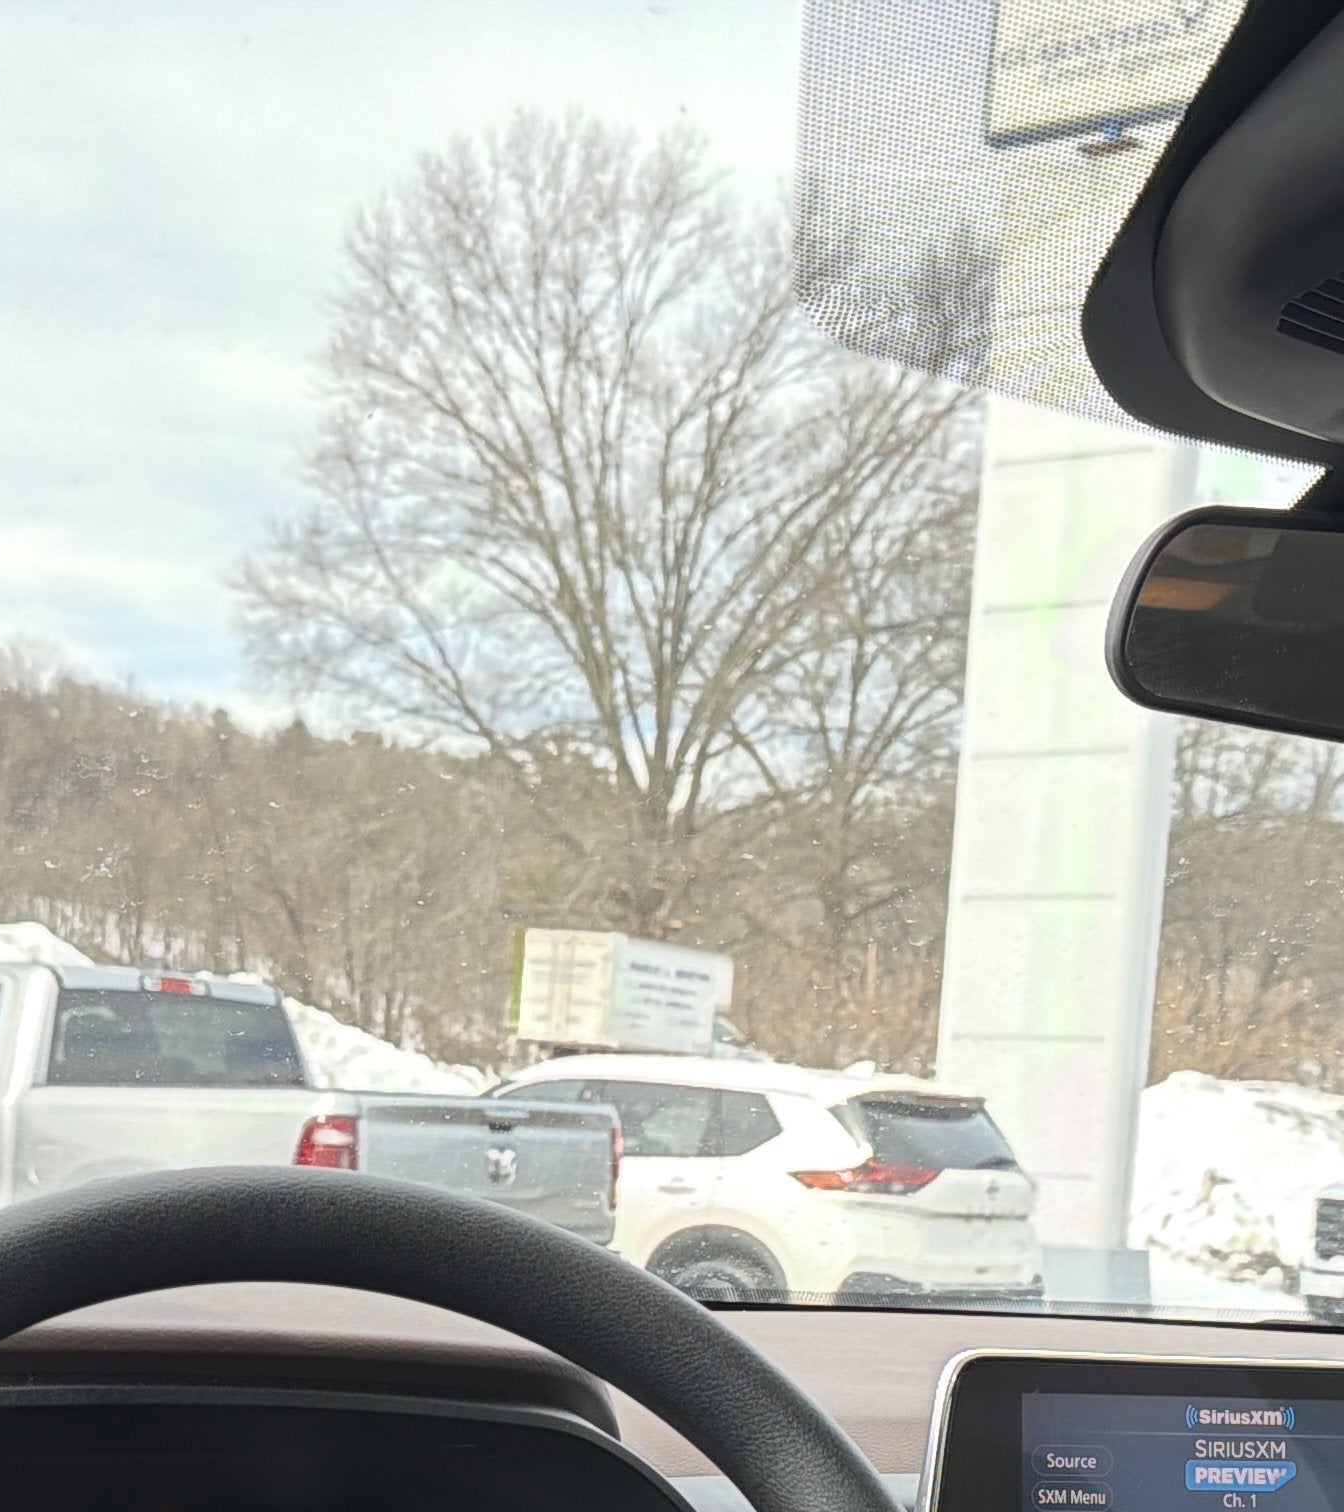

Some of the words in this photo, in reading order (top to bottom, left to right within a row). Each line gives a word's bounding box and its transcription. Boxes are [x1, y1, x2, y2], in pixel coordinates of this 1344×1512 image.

[1195, 1440, 1286, 1459] SIRIUSXM
[1047, 1453, 1097, 1469] Source
[1195, 1467, 1287, 1485] PREVIEW
[1038, 1489, 1066, 1505] SXM
[1070, 1490, 1106, 1505] Menu
[1223, 1494, 1246, 1508] Ch.
[1250, 1494, 1257, 1508] 1
